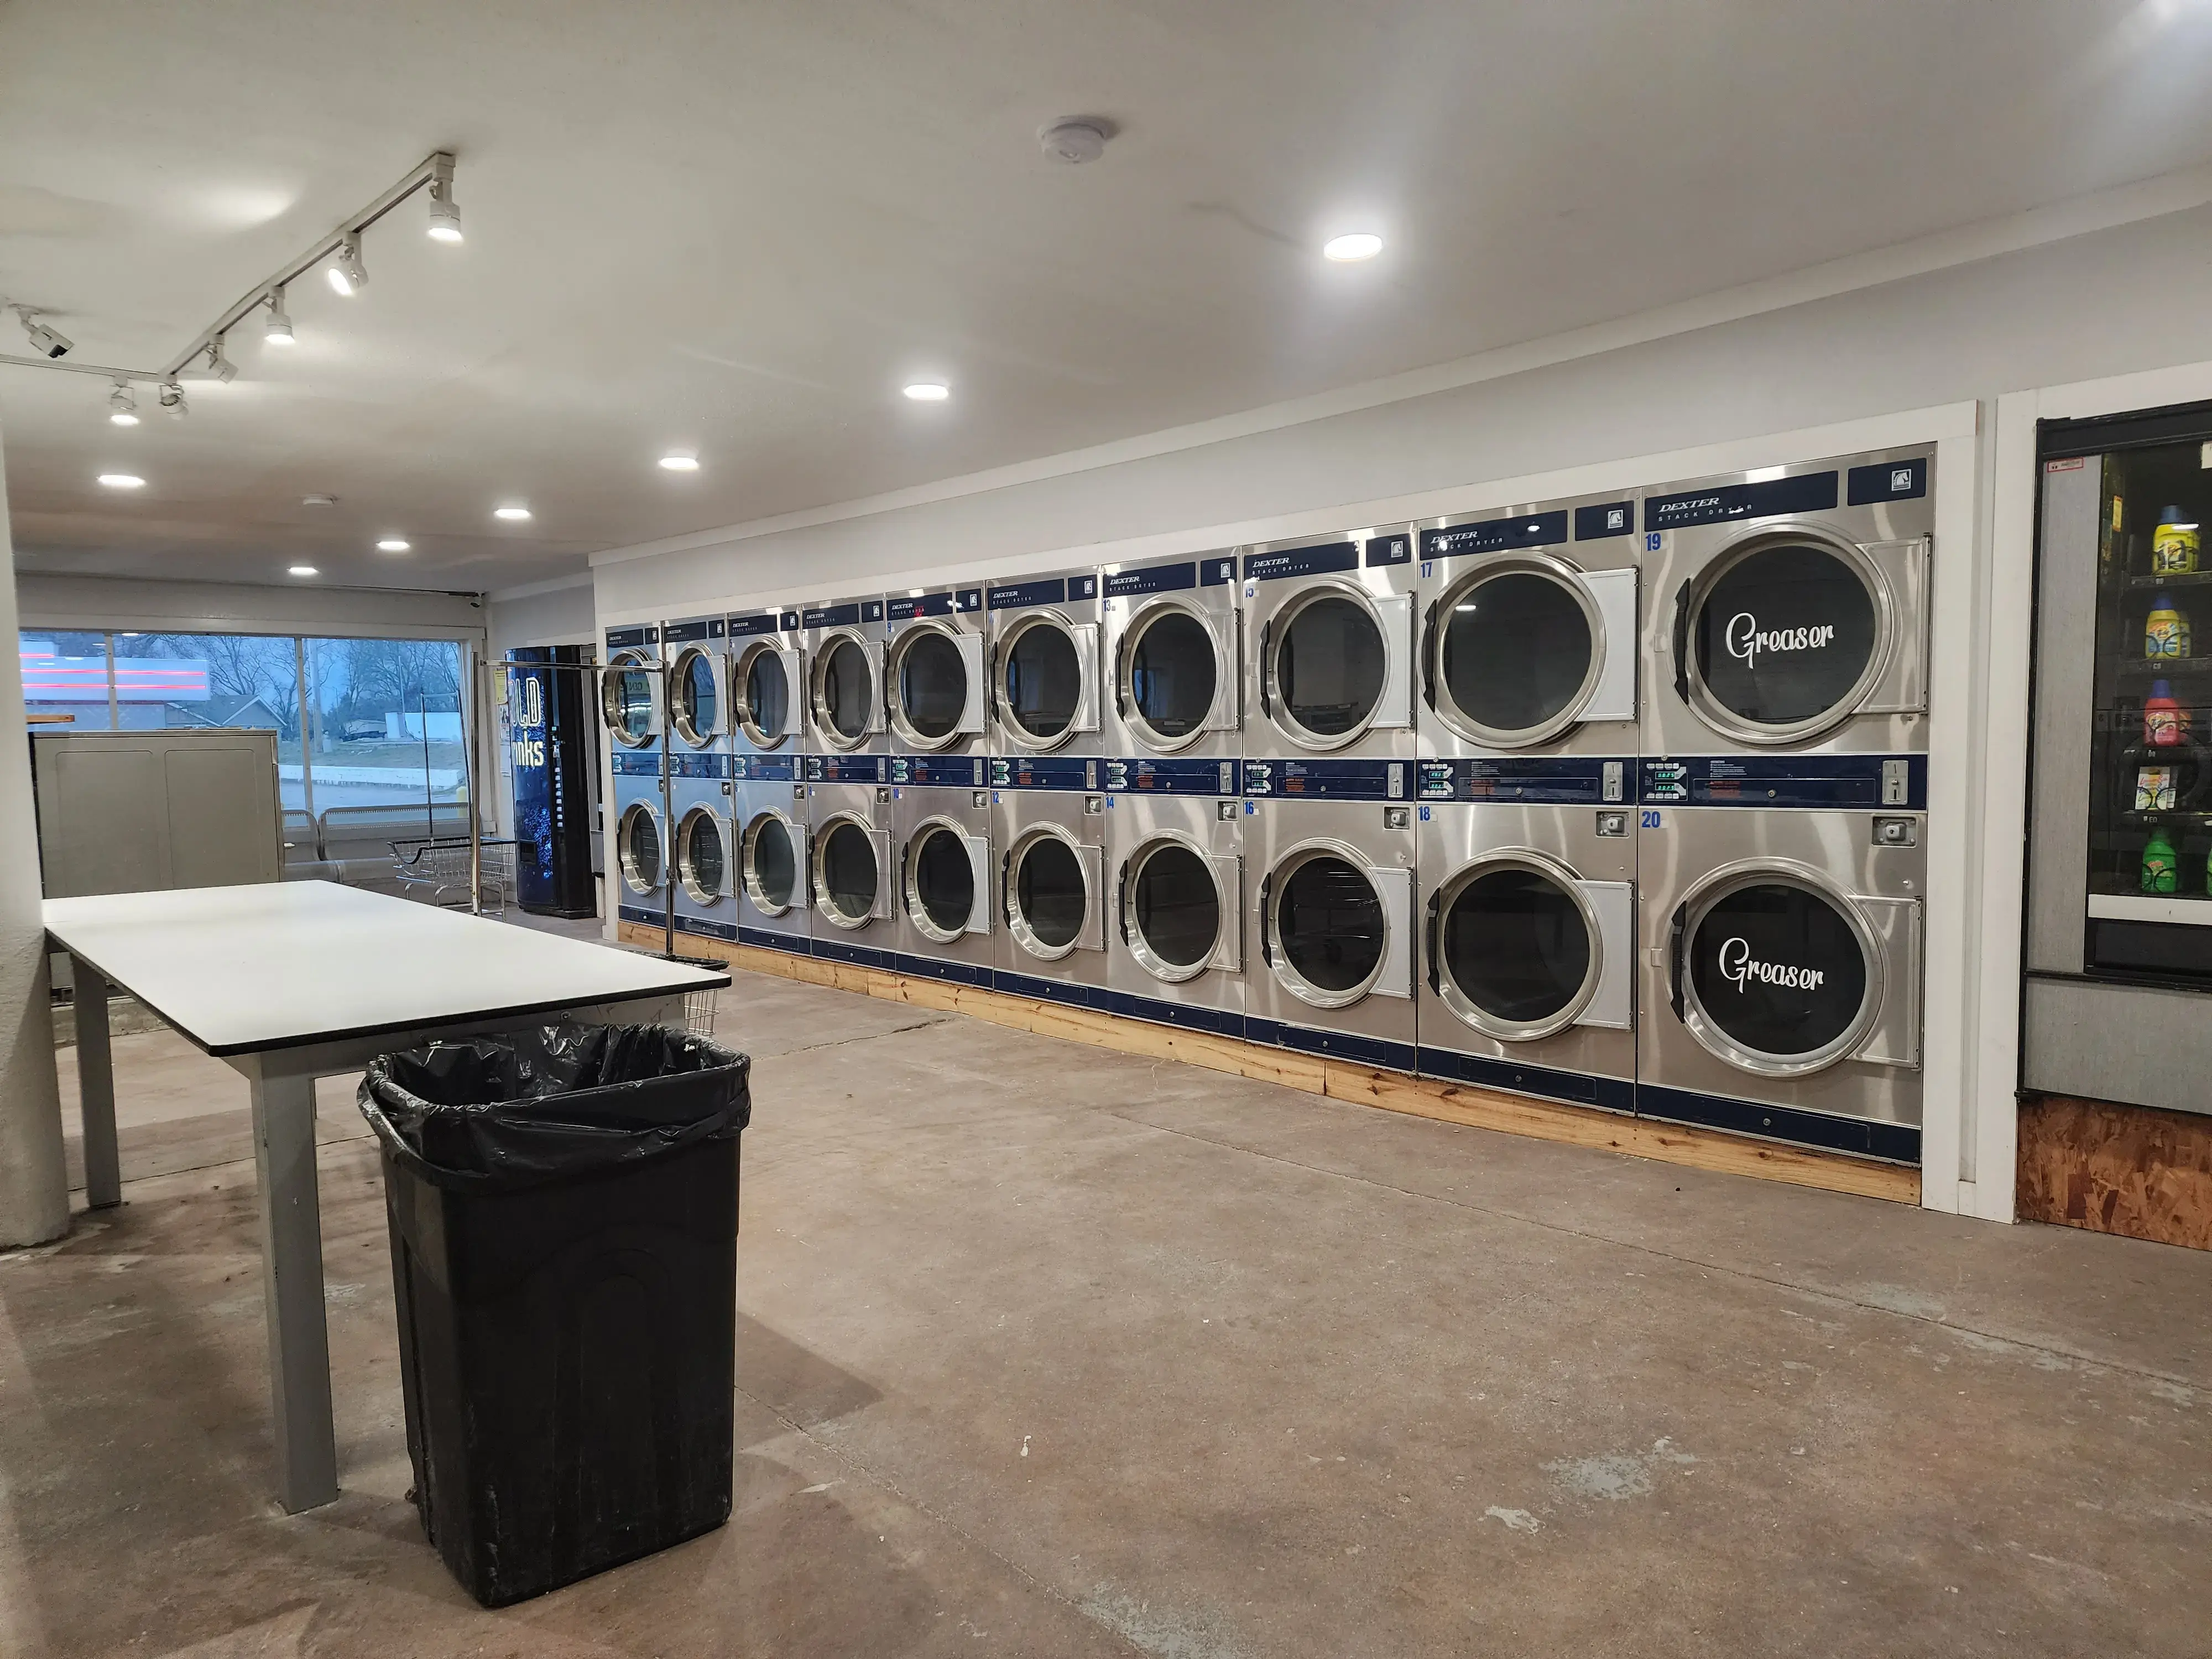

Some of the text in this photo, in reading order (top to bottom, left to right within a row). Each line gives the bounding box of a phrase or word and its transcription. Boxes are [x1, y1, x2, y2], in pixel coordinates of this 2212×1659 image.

[1658, 497, 1720, 513] DEXTER
[1658, 511, 1698, 522] STACK
[1431, 531, 1479, 544] DEXTER
[1646, 533, 1661, 551] 19
[1430, 538, 1504, 552] STCK DRYER
[1253, 557, 1291, 568] DEXTER
[1420, 561, 1433, 578] 17
[1109, 576, 1140, 585] DEXTER
[993, 591, 1019, 599] DEXTER
[1103, 599, 1111, 612] 13
[888, 622, 892, 633] 9
[1726, 612, 1834, 669] Greaser
[893, 788, 899, 800] 10
[992, 791, 999, 804] 12
[1105, 796, 1114, 809] 14
[1244, 801, 1254, 815] 16
[1418, 806, 1431, 821] 18
[1641, 811, 1661, 828] 20
[1719, 937, 1824, 994] Greaser
